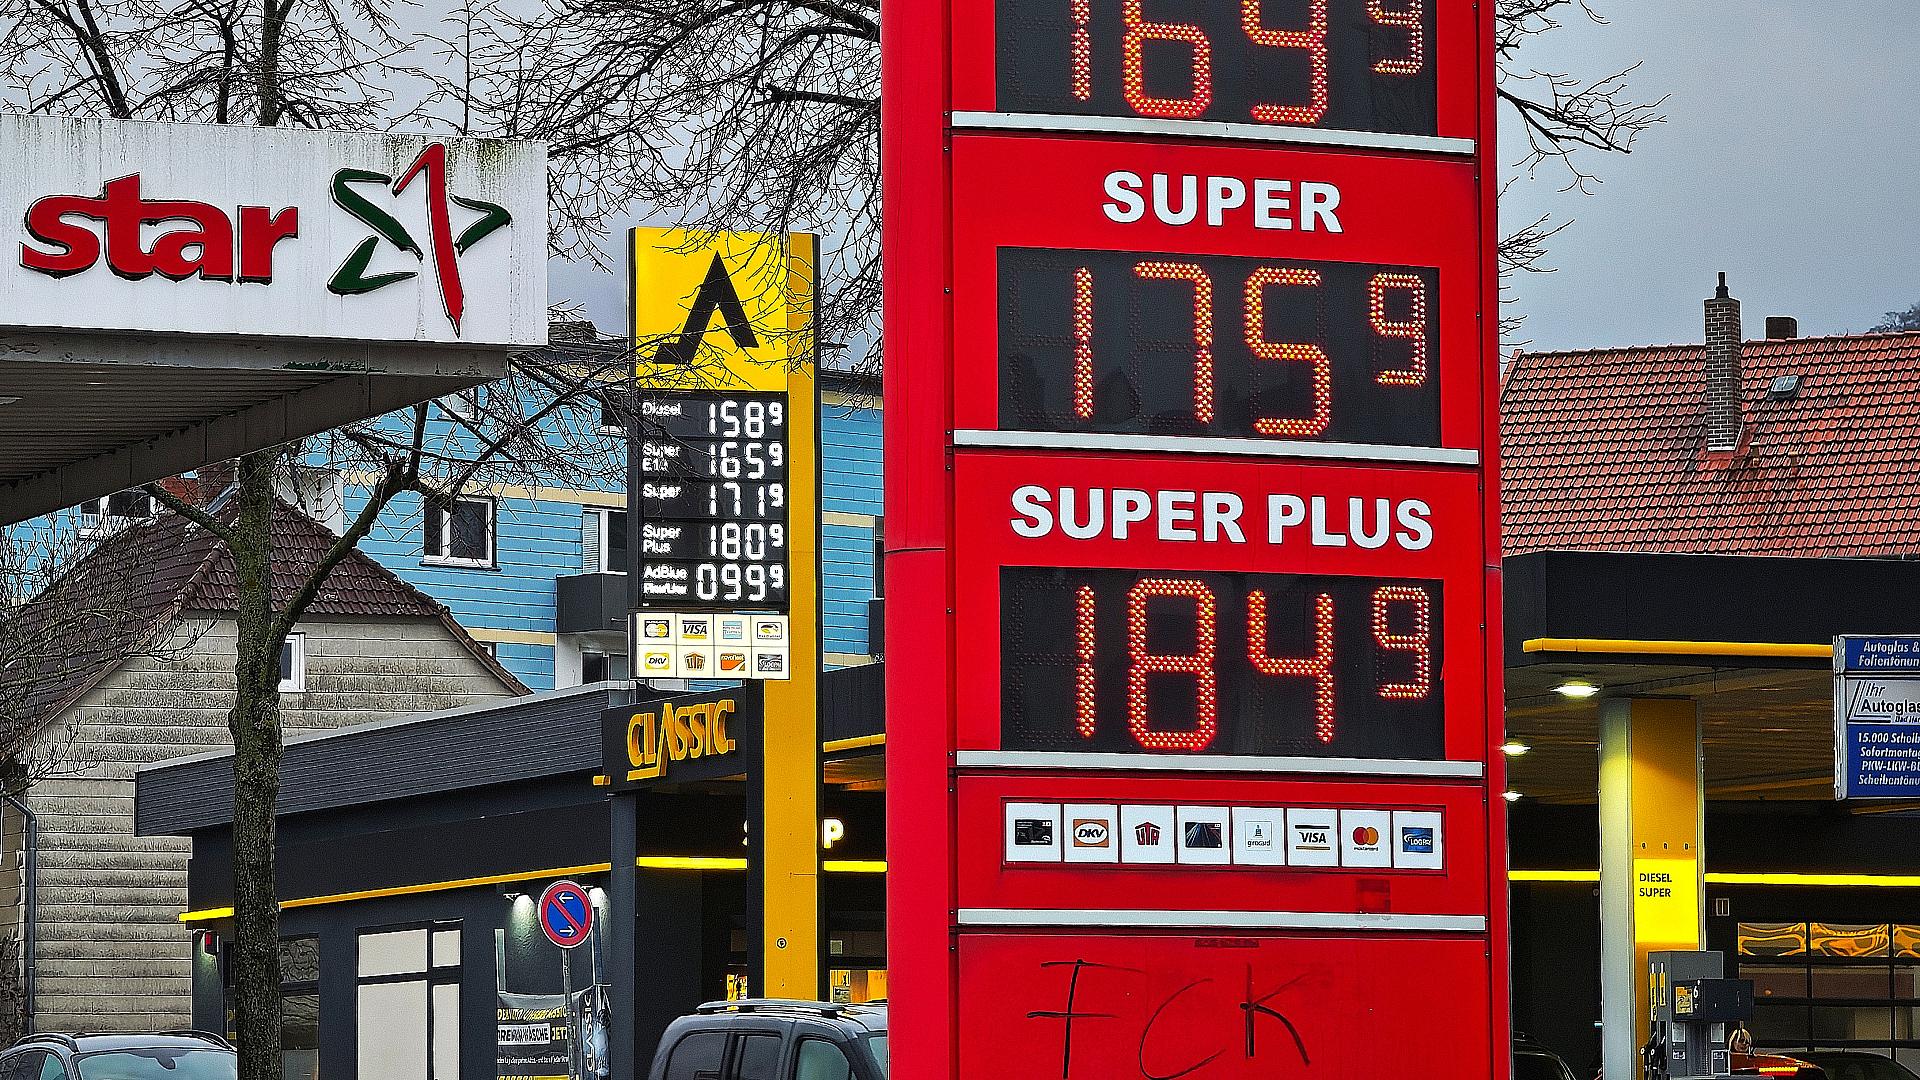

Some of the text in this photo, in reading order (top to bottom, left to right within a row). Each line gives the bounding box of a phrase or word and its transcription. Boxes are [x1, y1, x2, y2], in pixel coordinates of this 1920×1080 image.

[1102, 170, 1345, 233] SUPER
[20, 171, 299, 284] star
[642, 442, 681, 458] Super
[642, 483, 682, 500] Super
[1009, 485, 1434, 551] SUPER PLUS
[642, 522, 682, 539] Super
[642, 539, 672, 553] Plus
[643, 564, 688, 580] AdBlue
[683, 624, 708, 635] VISA
[1863, 640, 1920, 655] Autoglas &
[648, 657, 668, 665] DKV
[1866, 682, 1886, 697] Ihr
[627, 700, 736, 781] CLASSIC
[1858, 733, 1889, 743] 15.000
[1078, 828, 1104, 838] DKV
[1135, 822, 1160, 845] UTA
[1299, 831, 1327, 844] VISA
[1639, 873, 1672, 883] DIESEL
[1639, 888, 1671, 897] SUPER
[1026, 958, 1312, 1080] FCK
[584, 994, 596, 1072] CLASSIC
